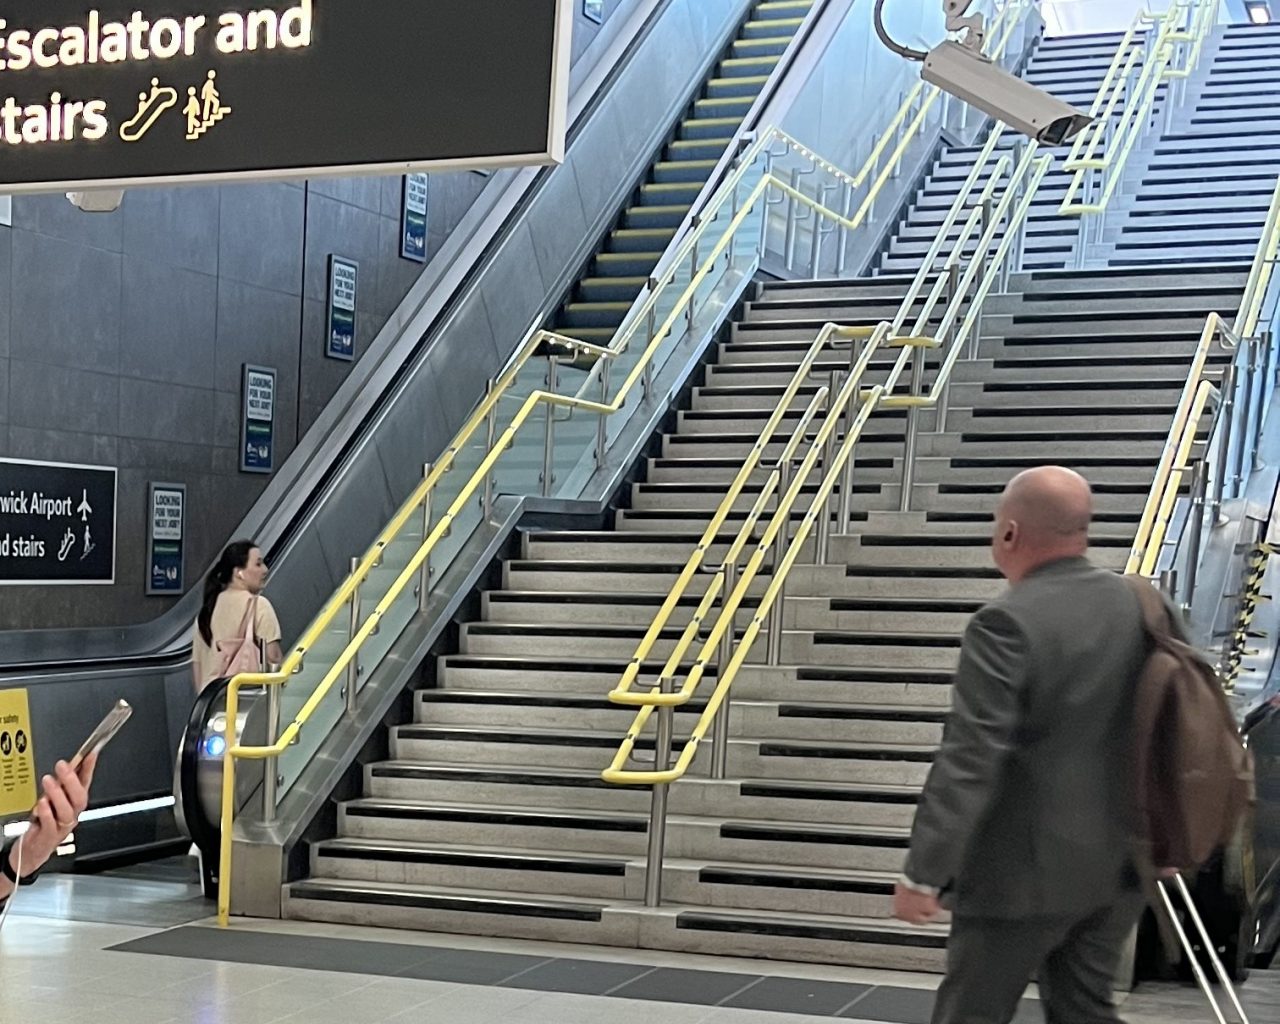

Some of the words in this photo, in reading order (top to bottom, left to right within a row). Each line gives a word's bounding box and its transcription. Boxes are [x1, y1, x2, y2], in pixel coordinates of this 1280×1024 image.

[216, 0, 312, 53] and
[30, 492, 72, 521] Airport
[155, 495, 180, 506] LOOKING
[155, 507, 166, 517] FOR
[167, 508, 180, 518] YOUR
[12, 534, 45, 558] stairs
